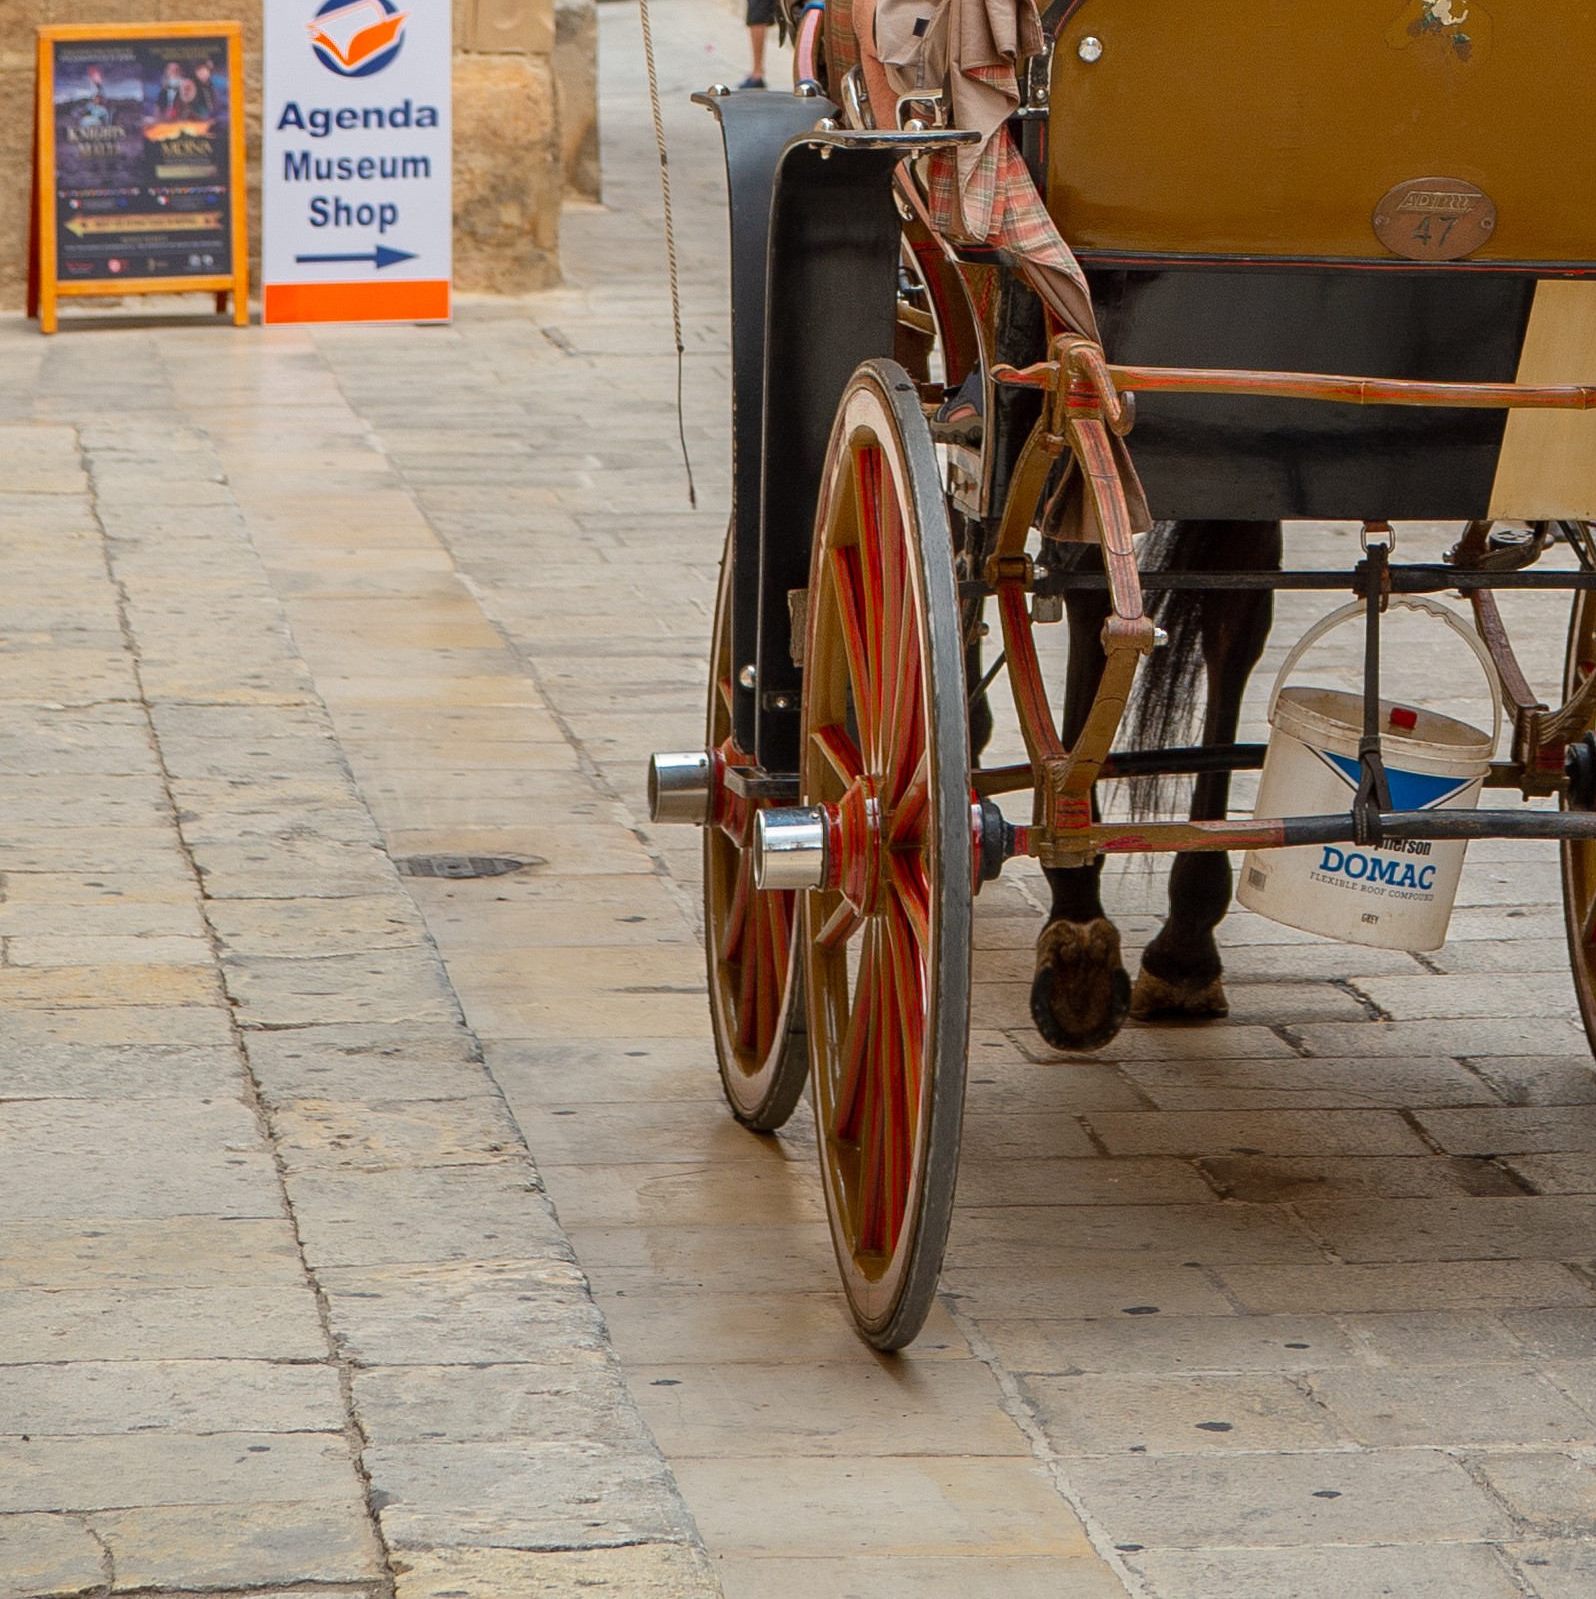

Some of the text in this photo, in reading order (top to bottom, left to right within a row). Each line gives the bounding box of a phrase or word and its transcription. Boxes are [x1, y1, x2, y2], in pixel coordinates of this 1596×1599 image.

[276, 99, 439, 138] Agenda
[283, 151, 431, 182] Museum
[309, 196, 399, 233] Shop
[1410, 215, 1459, 248] 47
[1320, 847, 1436, 890] DOMAC
[1310, 872, 1435, 903] FLEXIBLE ROOF COMPOUND
[1361, 913, 1380, 925] GREY
